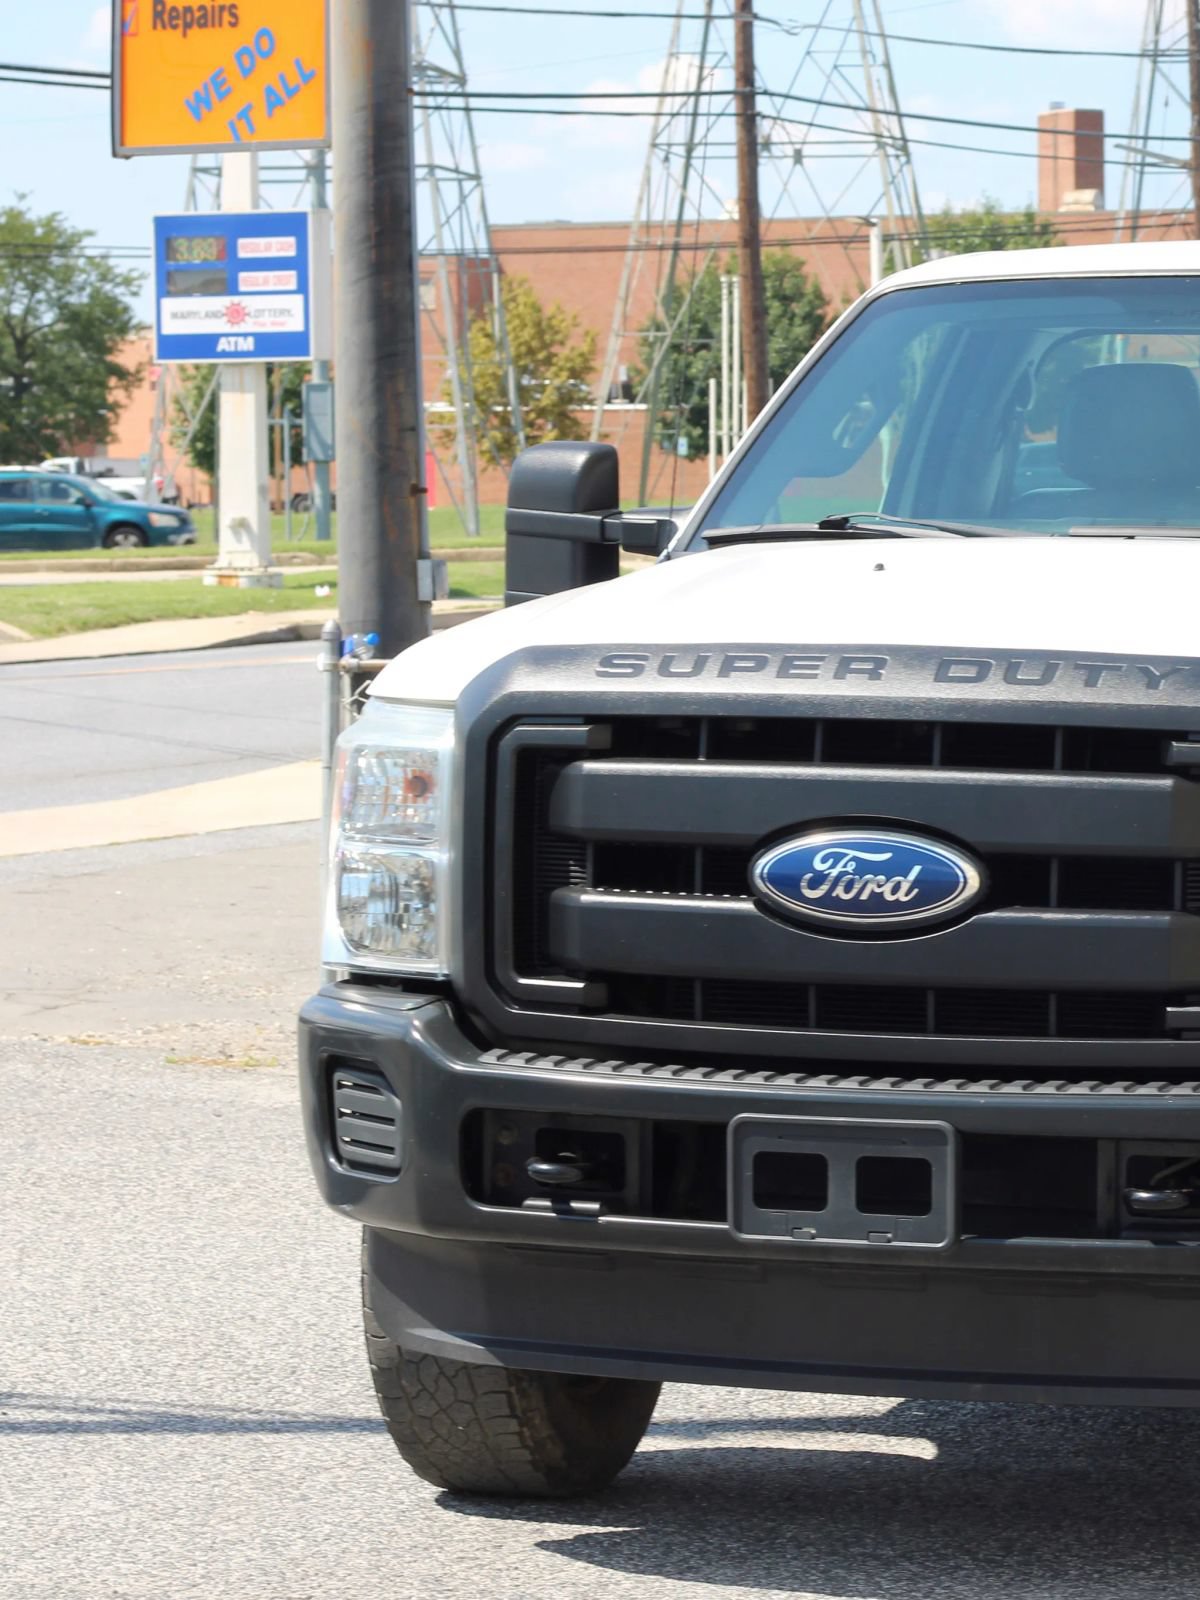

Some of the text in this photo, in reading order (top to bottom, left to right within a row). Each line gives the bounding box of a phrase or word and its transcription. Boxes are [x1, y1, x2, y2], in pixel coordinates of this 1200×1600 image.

[152, 0, 239, 39] Repairs
[184, 27, 276, 122] WE DO
[227, 58, 316, 143] IT ALL
[170, 310, 224, 320] MARYLAND
[215, 336, 255, 353] ATM
[594, 652, 1193, 691] SUPER DUTY
[799, 847, 923, 902] Ford
